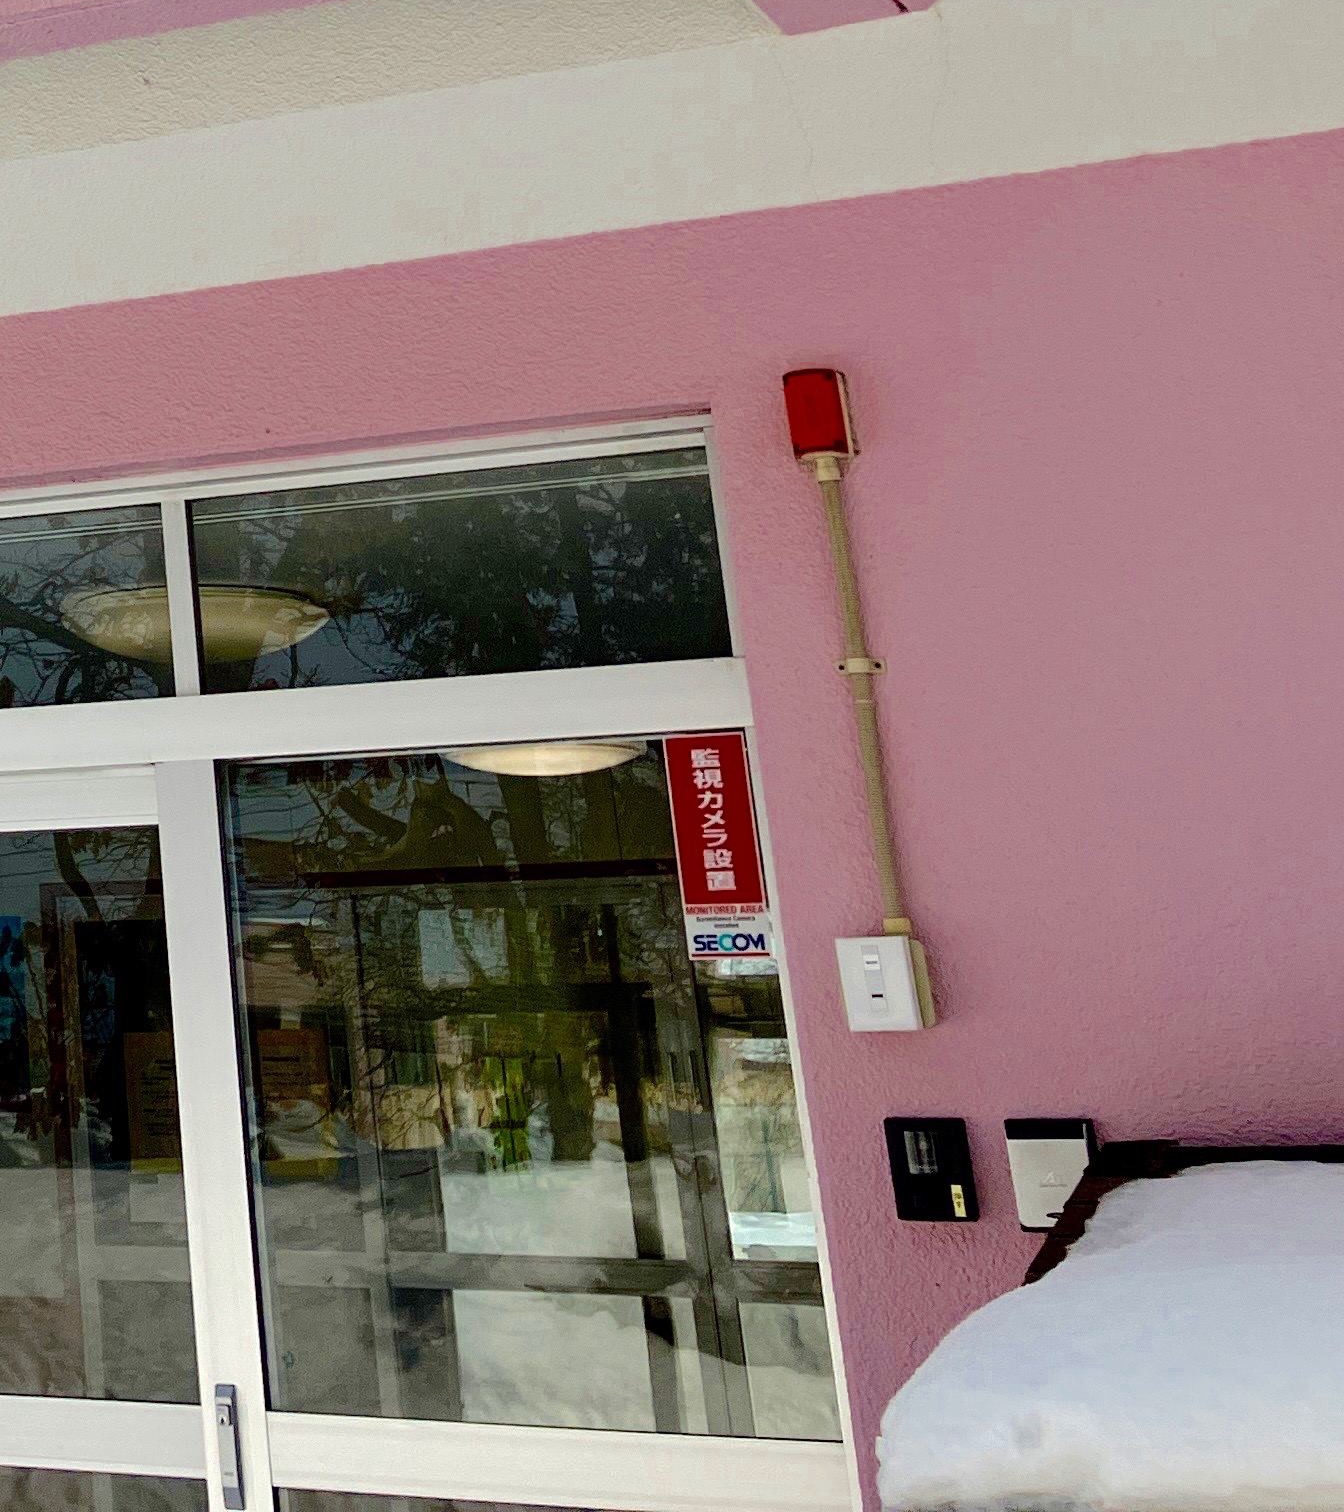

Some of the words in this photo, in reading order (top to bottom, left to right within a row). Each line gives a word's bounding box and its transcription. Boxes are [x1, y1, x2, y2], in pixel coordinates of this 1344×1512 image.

[690, 747, 737, 892] 監視カメラ設置
[685, 905, 737, 915] MONITORED
[740, 904, 764, 914] AREA
[693, 933, 766, 952] SECOM
